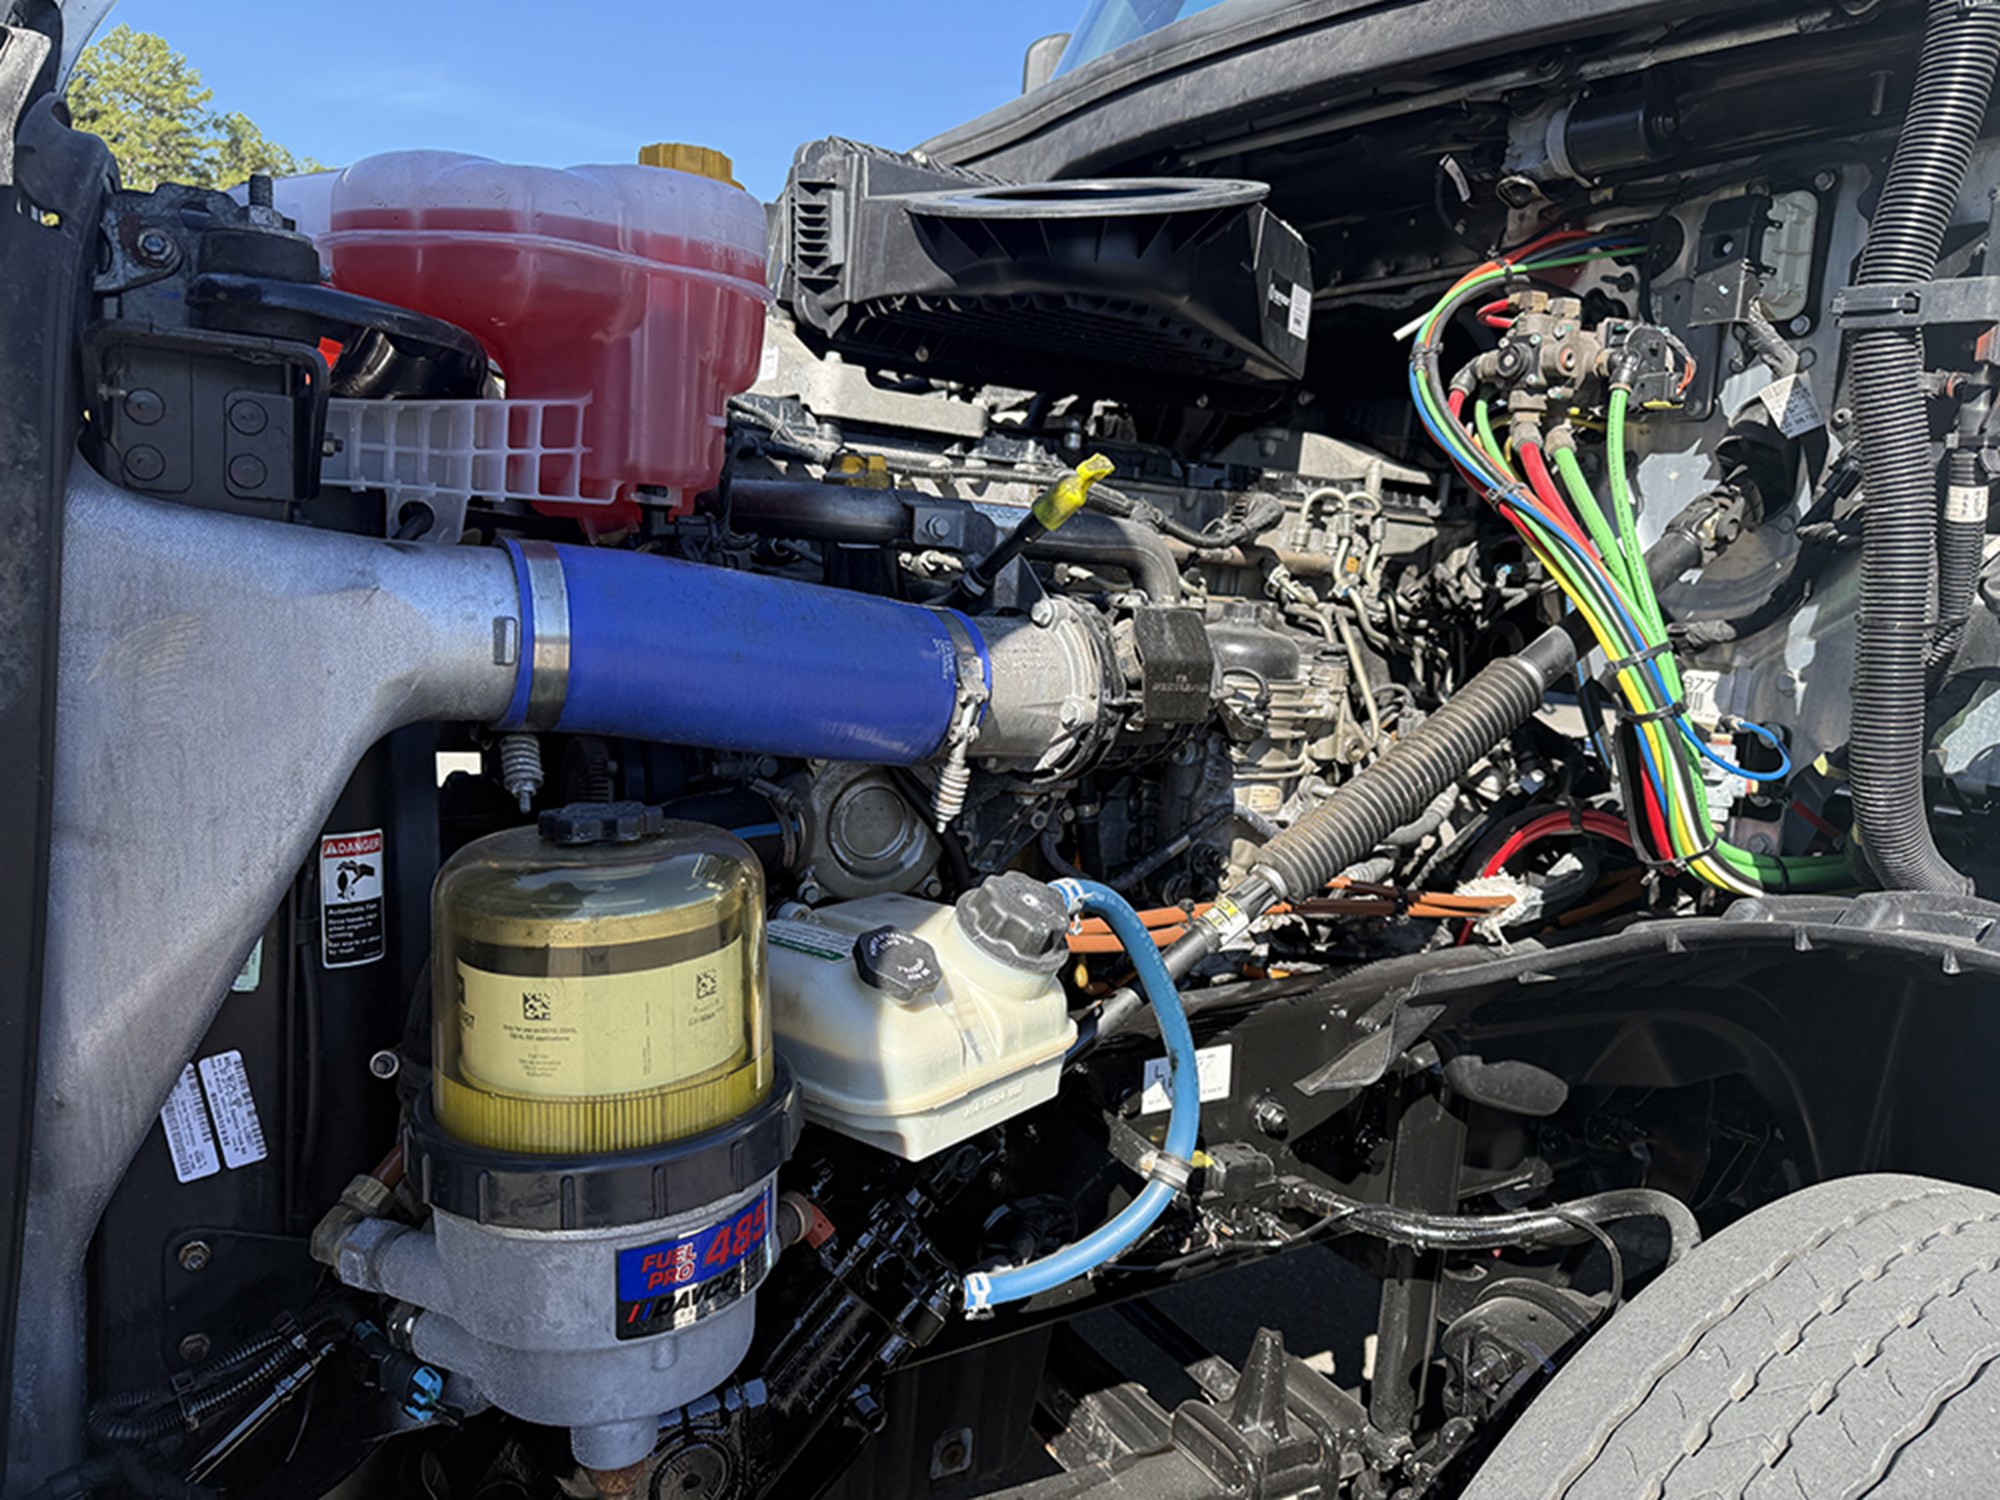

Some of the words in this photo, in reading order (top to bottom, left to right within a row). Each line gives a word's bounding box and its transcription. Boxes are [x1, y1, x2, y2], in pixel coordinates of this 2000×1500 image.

[339, 838, 380, 855] DANGER
[704, 1198, 768, 1267] 485
[641, 1243, 697, 1273] FUEL
[647, 1262, 695, 1291] PRO
[652, 1271, 737, 1318] DAVCO
